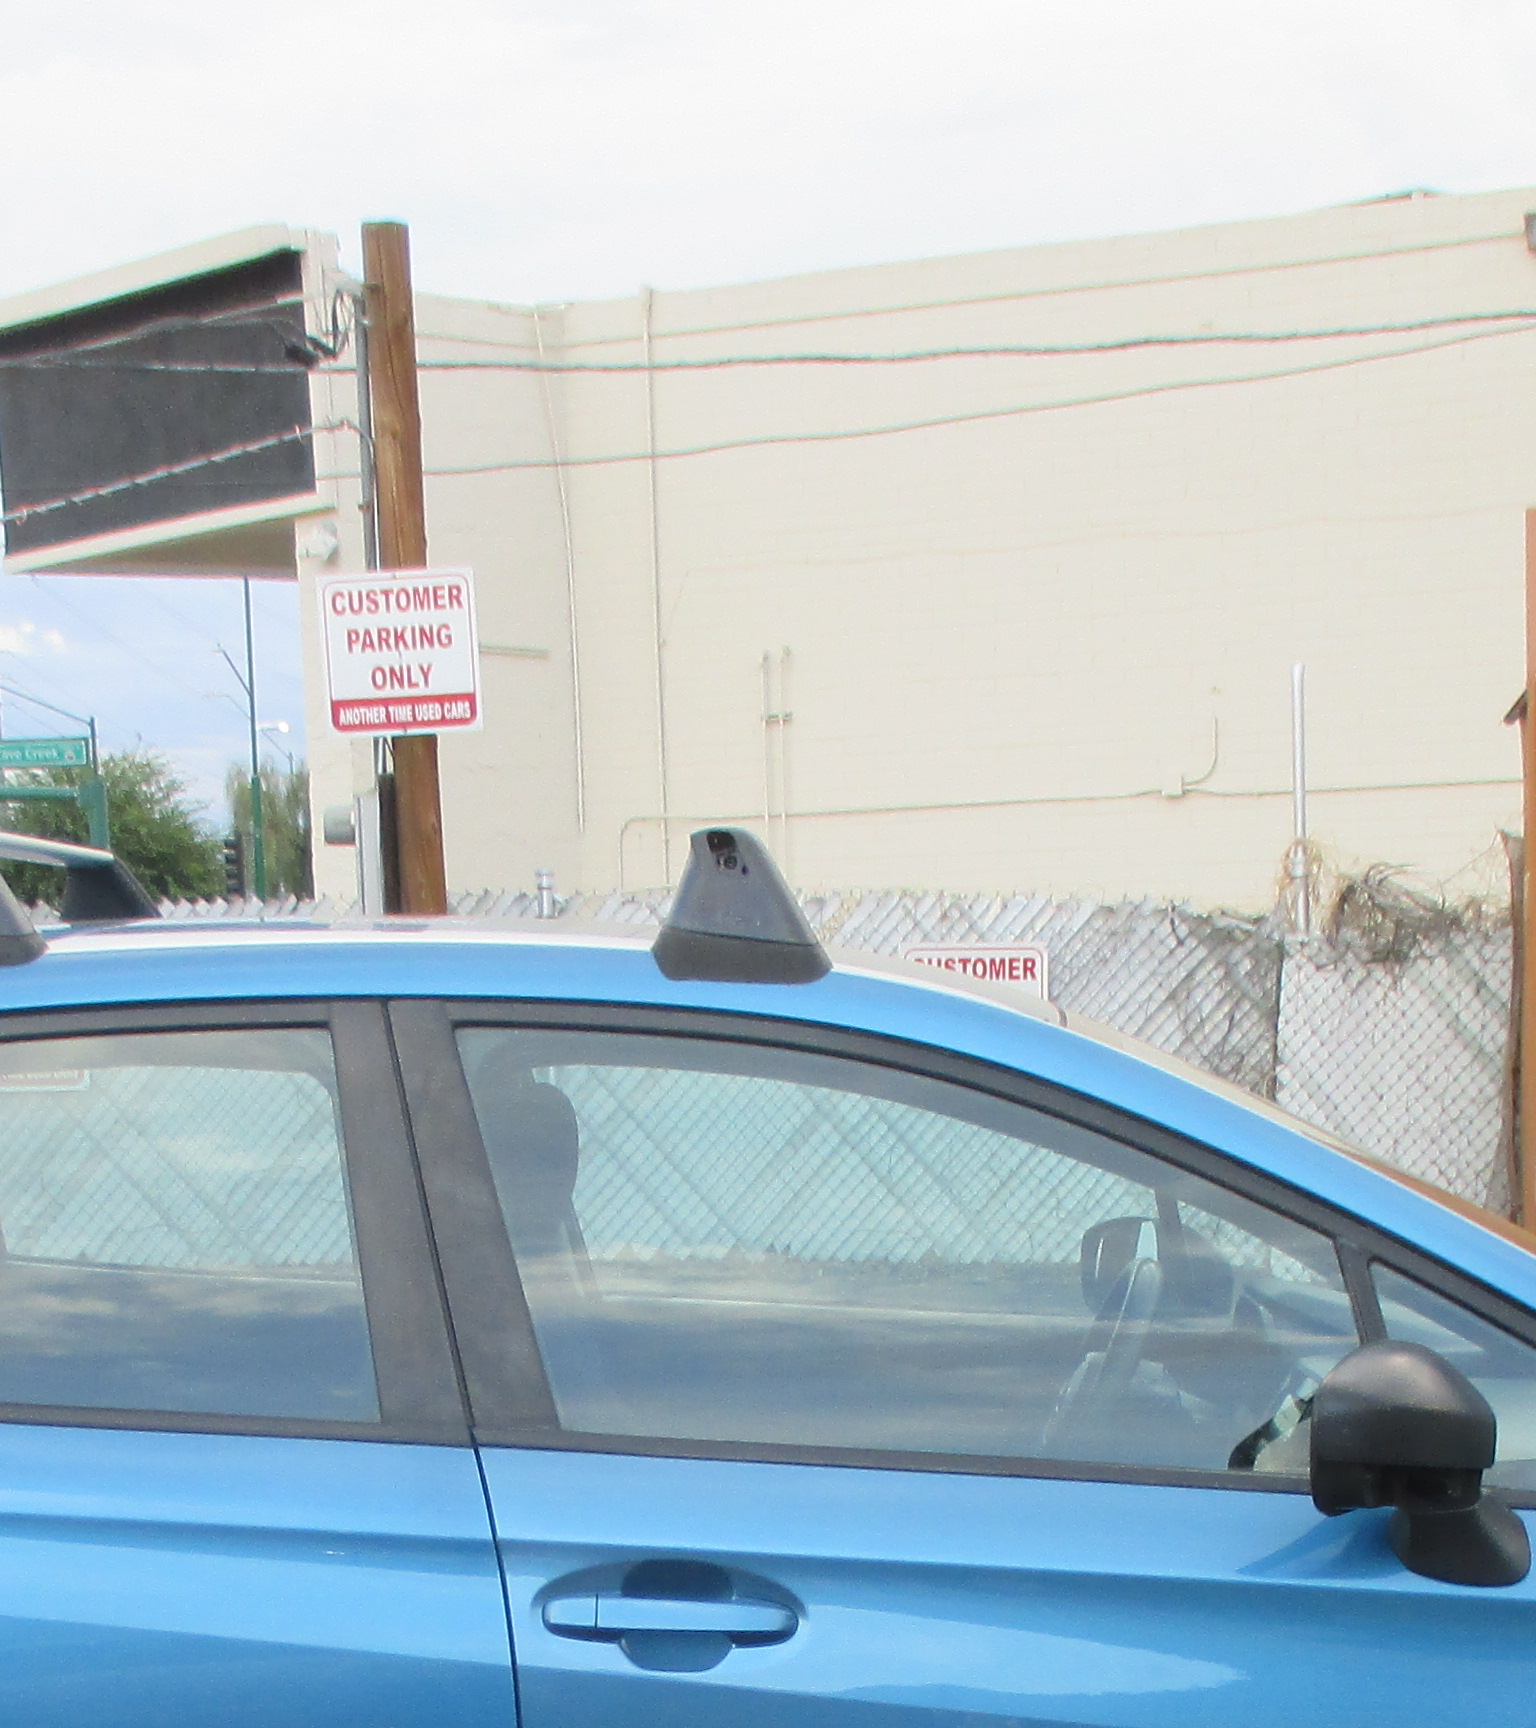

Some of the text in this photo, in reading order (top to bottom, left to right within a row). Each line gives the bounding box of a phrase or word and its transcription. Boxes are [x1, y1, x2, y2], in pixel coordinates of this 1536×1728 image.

[332, 585, 464, 616] CUSTOMER
[346, 624, 453, 654] PARKING
[371, 663, 433, 691] ONLY
[339, 700, 471, 726] ANOTHER TIME USED CARS
[914, 957, 1037, 981] STOMER
